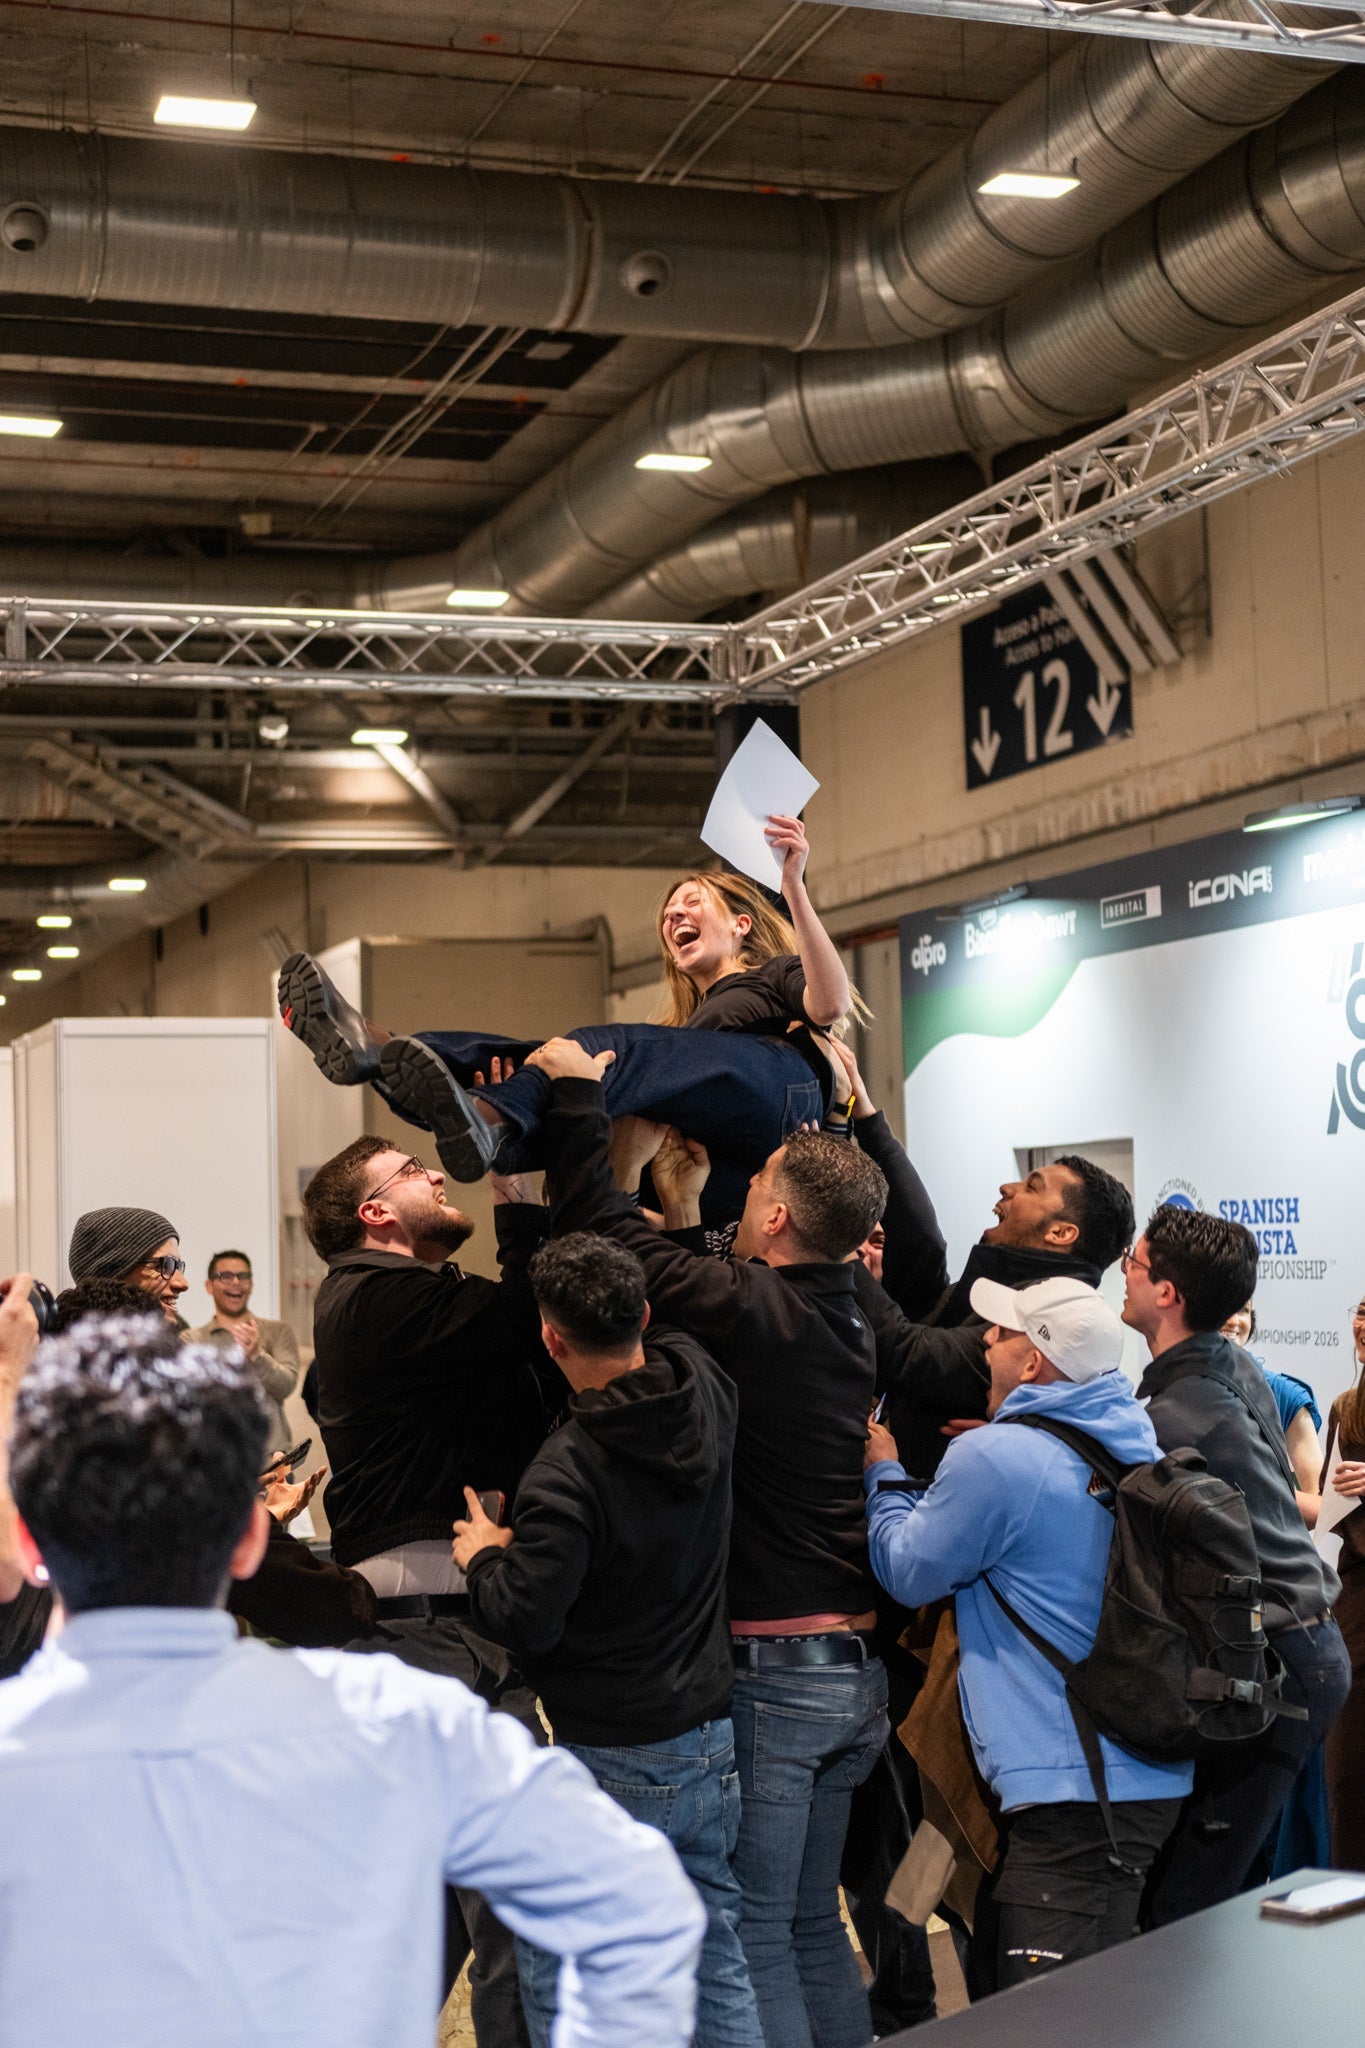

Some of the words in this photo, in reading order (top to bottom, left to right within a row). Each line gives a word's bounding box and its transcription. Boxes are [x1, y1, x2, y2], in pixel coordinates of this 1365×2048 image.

[1013, 657, 1074, 763] 12
[1105, 898, 1144, 920] IBERITAL
[911, 934, 947, 976] alpro
[1218, 1197, 1300, 1225] SPANISH
[1255, 1229, 1298, 1255] ISTA
[1313, 1330, 1340, 1347] 2026
[1026, 1949, 1064, 1960] BALANCE
